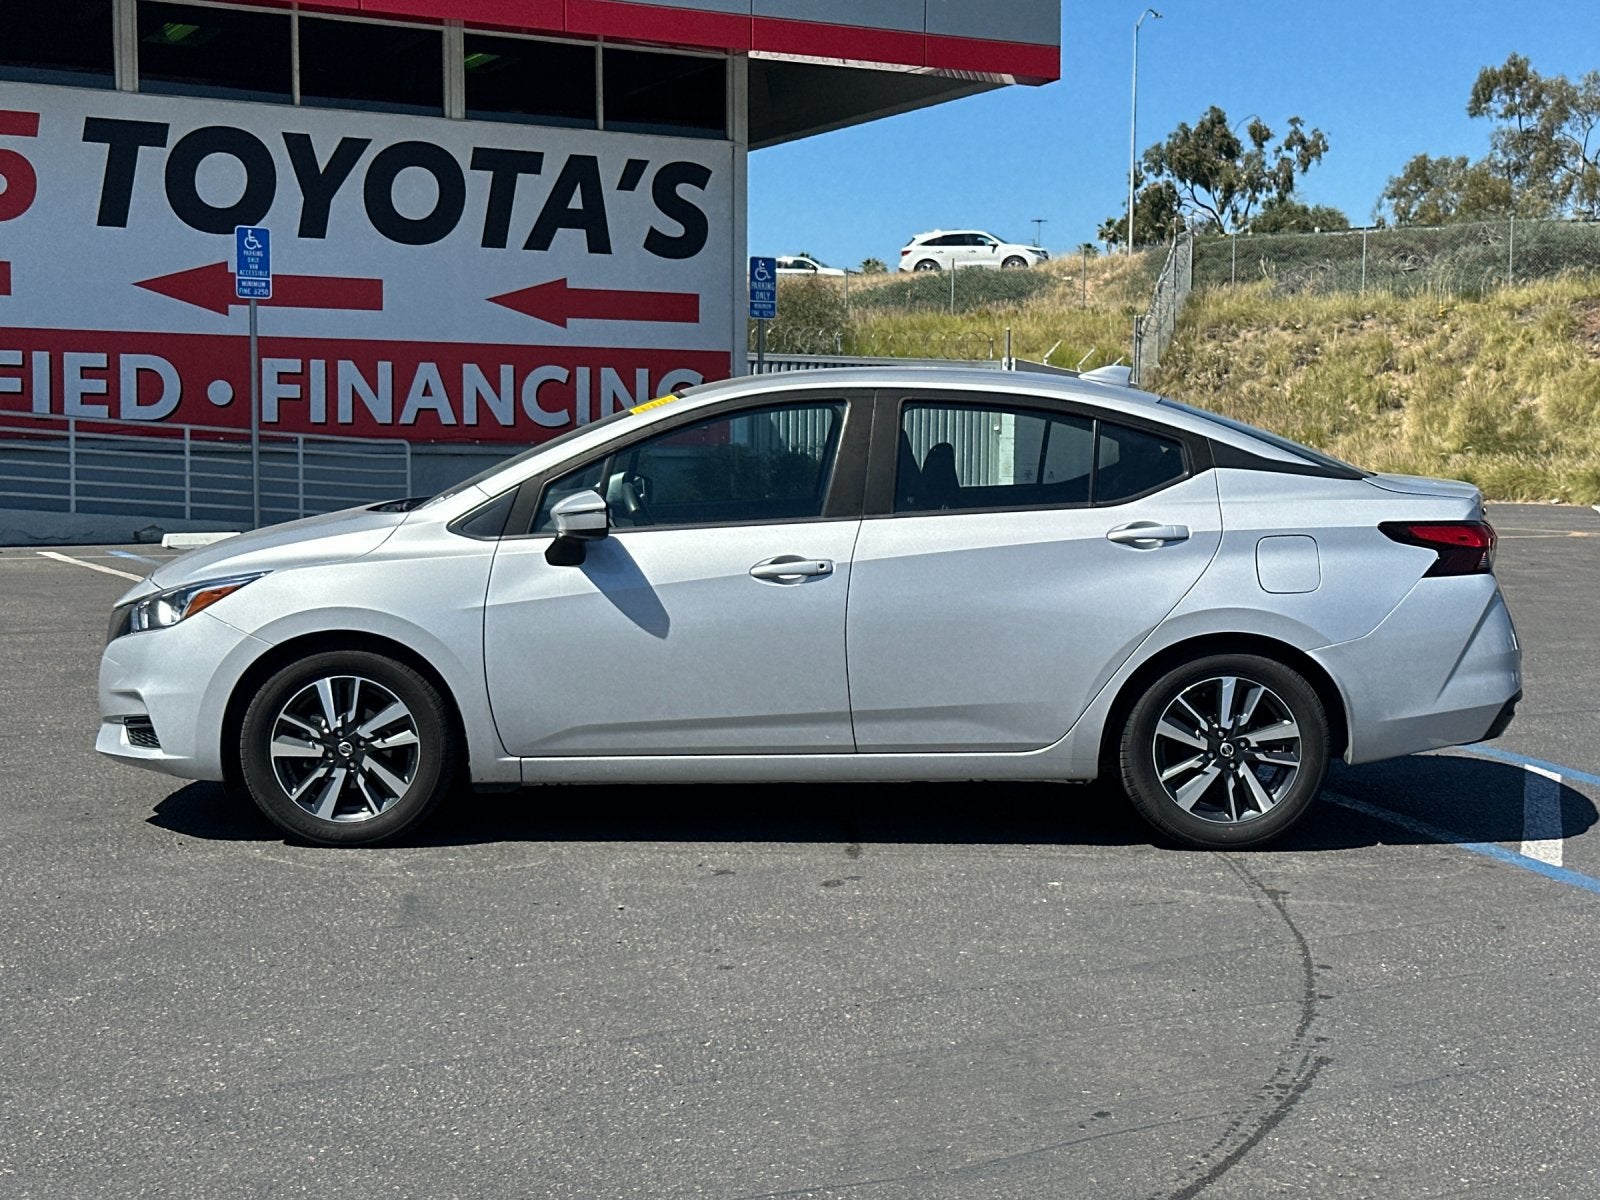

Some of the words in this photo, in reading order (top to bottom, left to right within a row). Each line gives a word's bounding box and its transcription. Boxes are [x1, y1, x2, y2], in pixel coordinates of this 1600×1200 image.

[82, 117, 713, 260] TOYOTA'S
[751, 281, 775, 291] PARKING
[755, 291, 770, 301] ONLY
